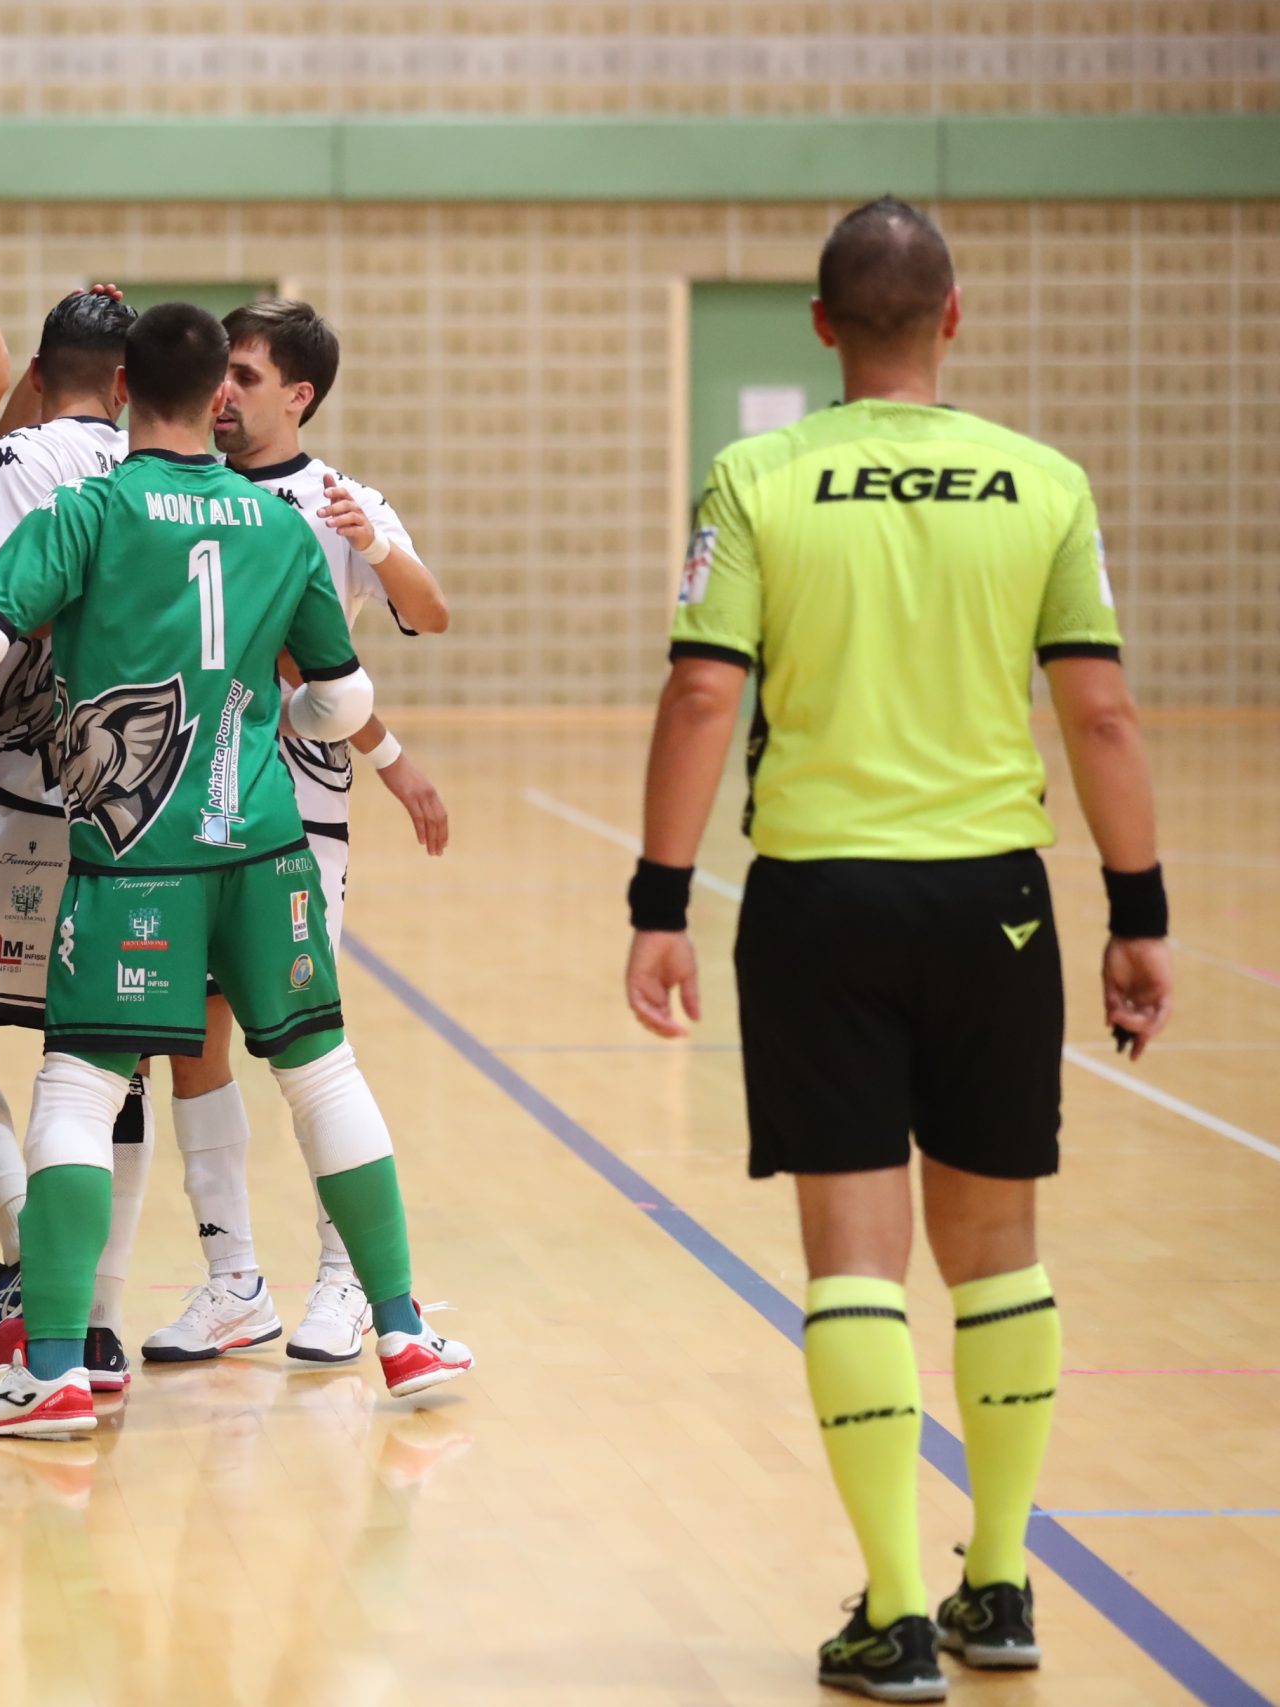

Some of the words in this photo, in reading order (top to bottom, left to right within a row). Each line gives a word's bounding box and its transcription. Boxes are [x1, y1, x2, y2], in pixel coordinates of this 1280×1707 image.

[815, 468, 1019, 503] LEGEA
[145, 491, 263, 526] MONTALTI
[188, 539, 225, 670] 1
[216, 680, 242, 745] Ponteggi
[210, 748, 226, 808] Adriatica
[0, 852, 66, 874] Fumagazzi
[112, 877, 182, 897] Fumagazzi
[117, 994, 145, 1002] INFISSI
